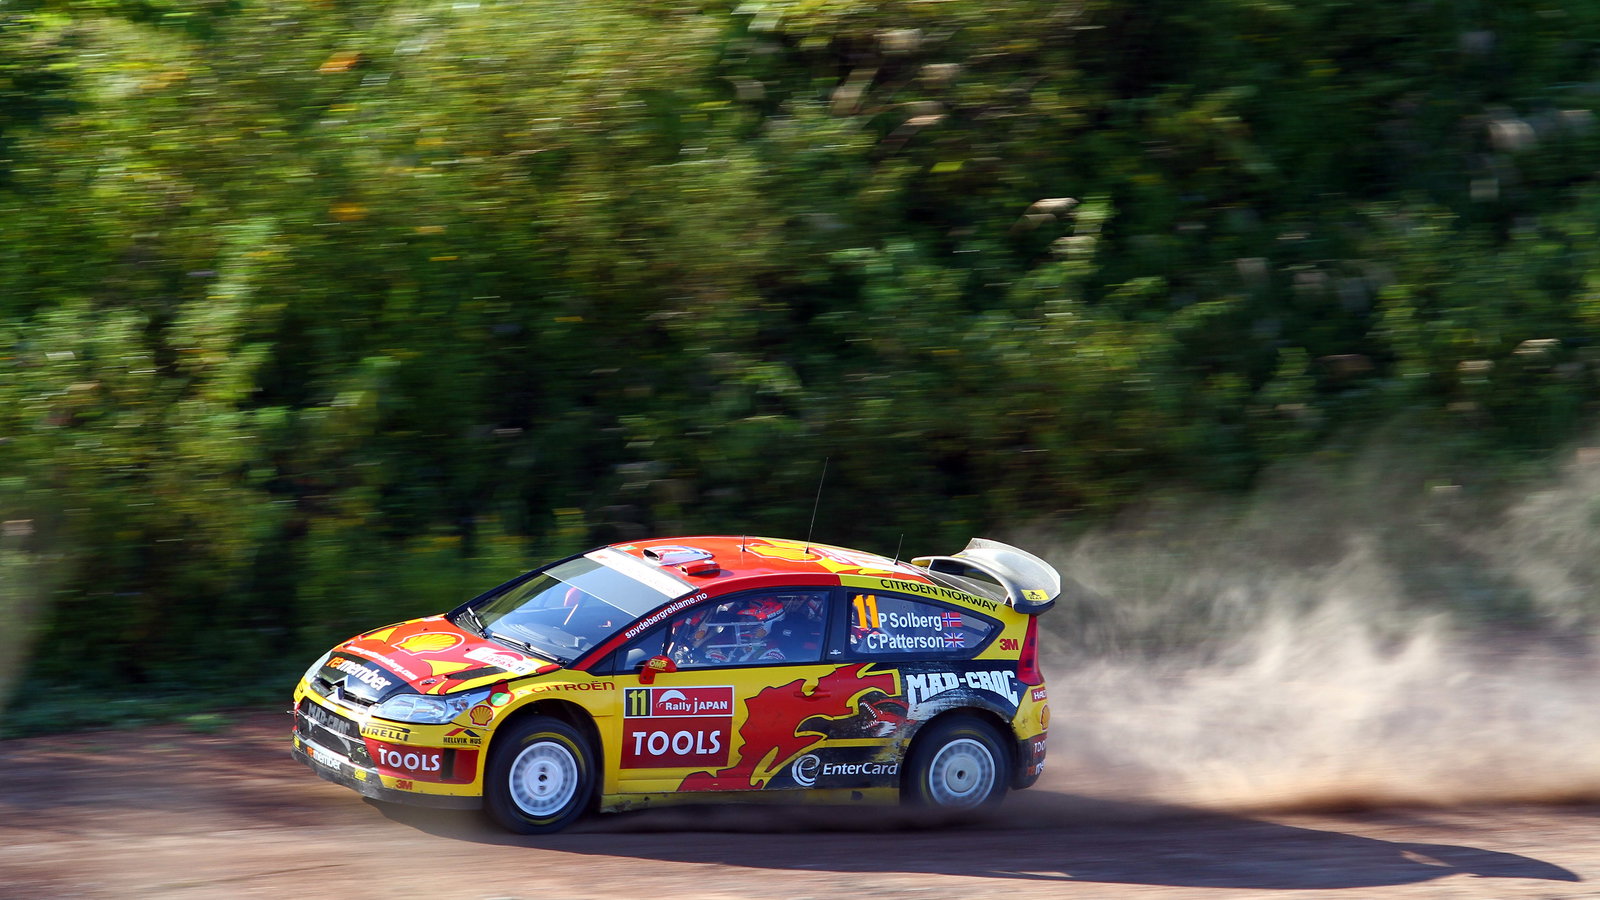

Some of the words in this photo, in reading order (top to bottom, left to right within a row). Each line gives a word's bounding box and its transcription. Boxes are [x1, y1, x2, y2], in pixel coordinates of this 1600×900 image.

[853, 594, 879, 629] 11
[940, 588, 998, 612] NORWAY
[625, 592, 708, 639] spydebergreklame.no
[890, 611, 942, 631] Solberg
[867, 634, 878, 649] C
[879, 633, 944, 649] Patterson
[1000, 638, 1019, 650] 3M
[650, 660, 667, 669] OMP
[629, 690, 647, 716] 11
[665, 702, 691, 712] Rally
[906, 671, 1019, 712] MAD-CROC
[632, 730, 721, 756] TOOLS
[378, 748, 440, 771] TOOLS
[822, 762, 898, 775] EnterCard
[395, 780, 413, 790] 3M
